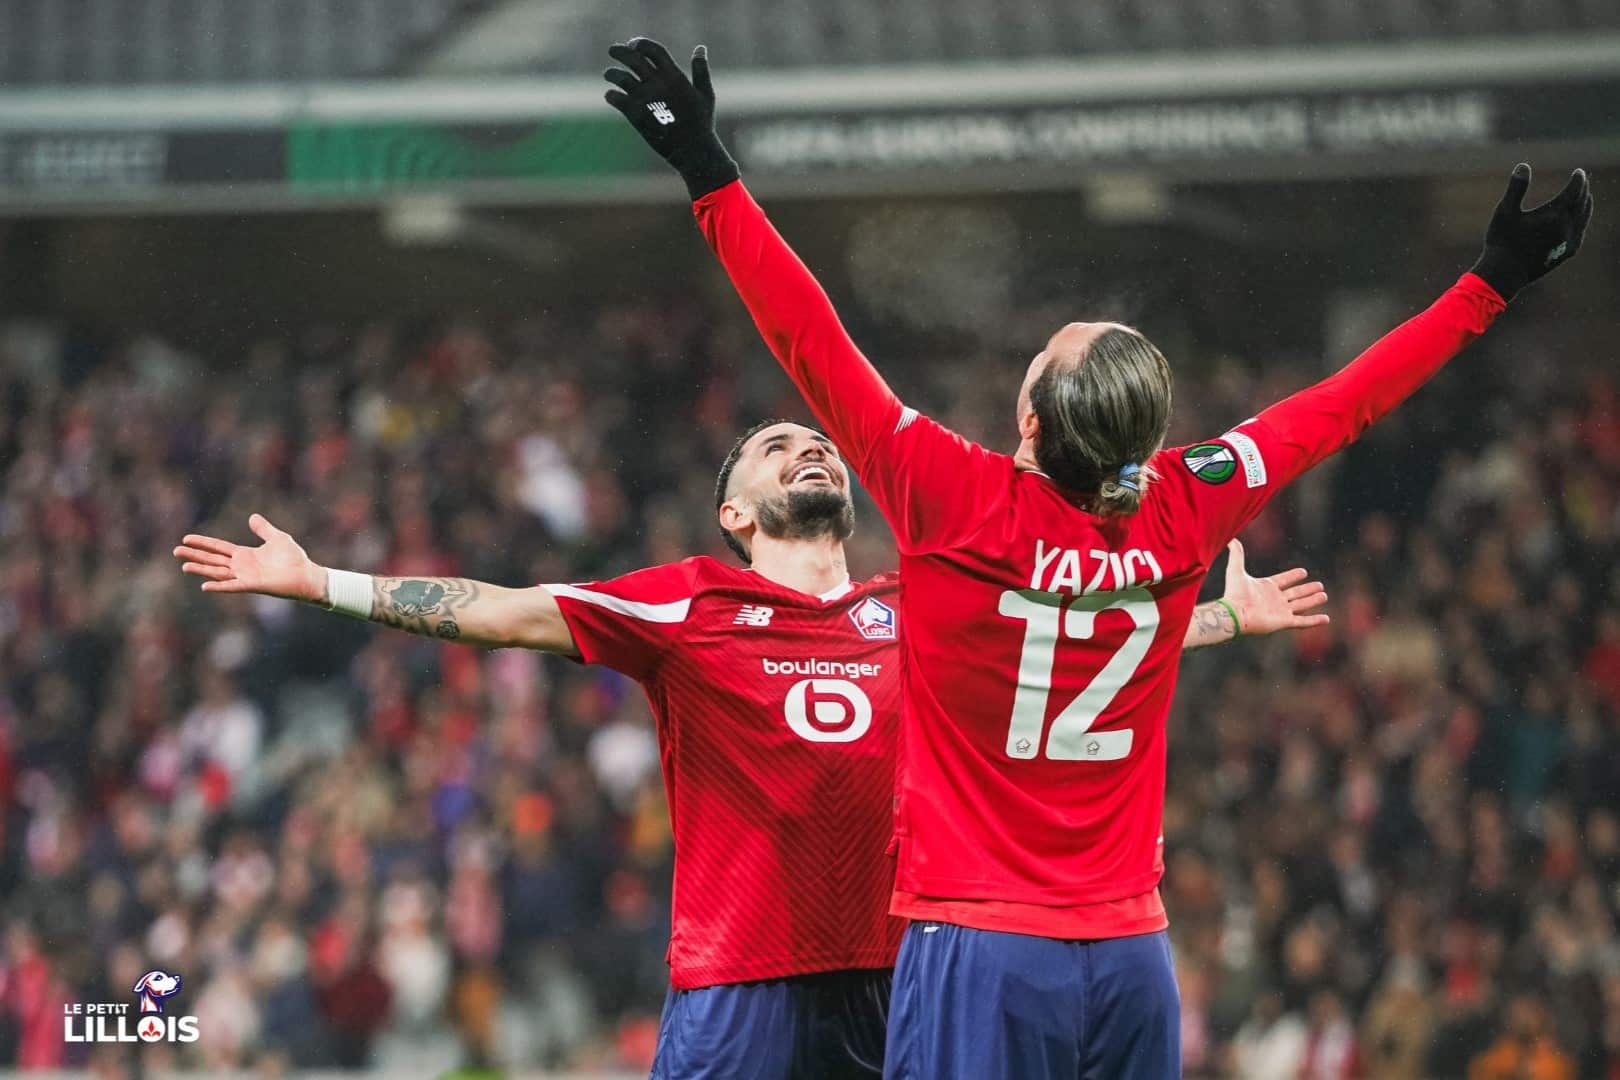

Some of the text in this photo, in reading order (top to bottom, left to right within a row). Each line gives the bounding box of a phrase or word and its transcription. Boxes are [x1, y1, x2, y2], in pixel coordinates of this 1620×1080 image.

[1029, 538, 1163, 596] YAZICI
[865, 627, 891, 637] LOSC
[762, 658, 882, 679] boulanger
[998, 588, 1160, 761] 12
